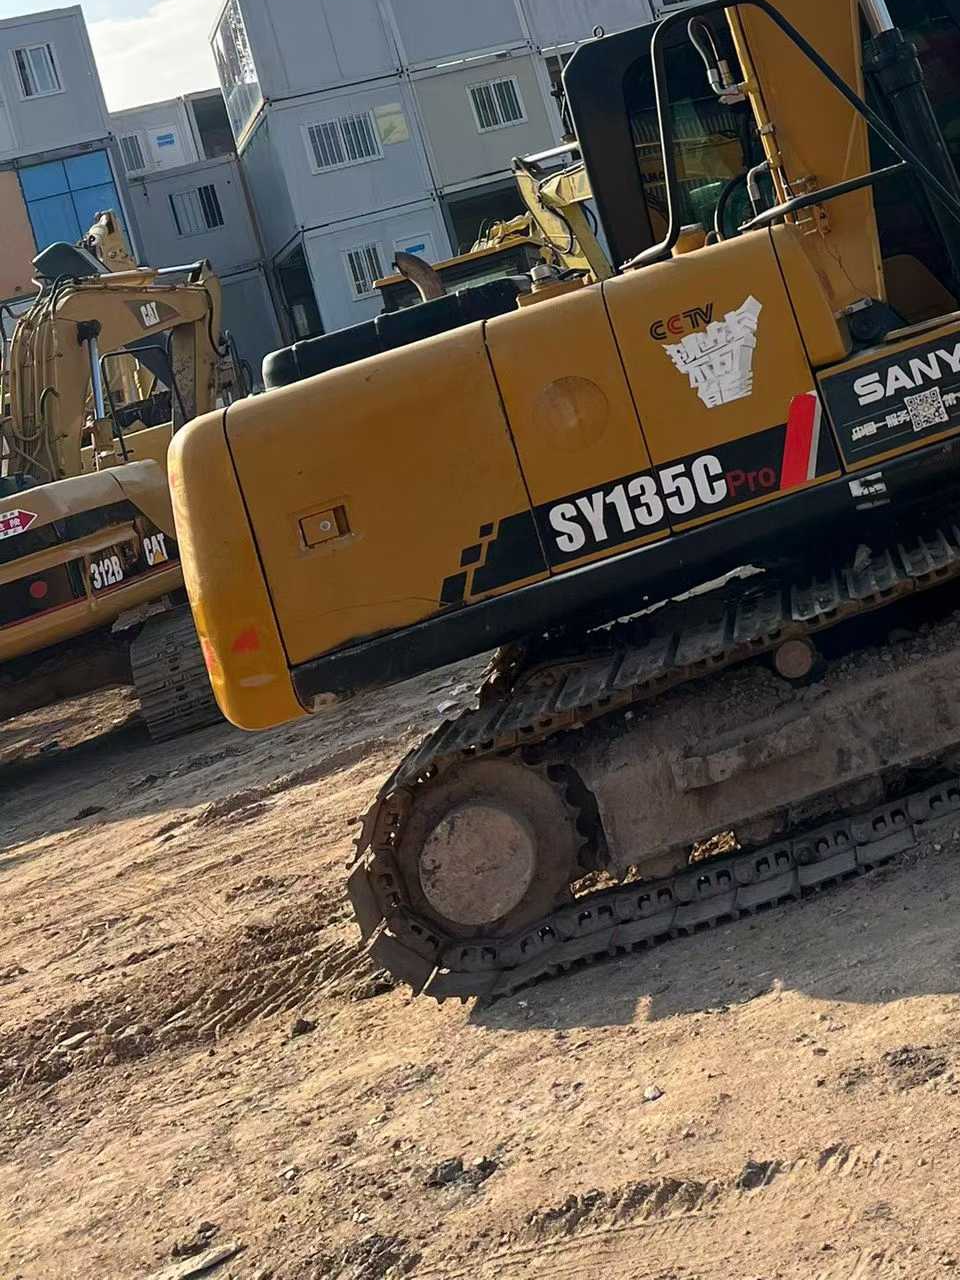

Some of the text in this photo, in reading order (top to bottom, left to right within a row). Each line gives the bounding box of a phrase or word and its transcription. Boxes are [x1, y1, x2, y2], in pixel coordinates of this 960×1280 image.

[140, 301, 160, 327] CAT
[650, 303, 713, 340] CCTV
[549, 454, 776, 553] SY135C Pro
[91, 533, 168, 589] 312B CAT
